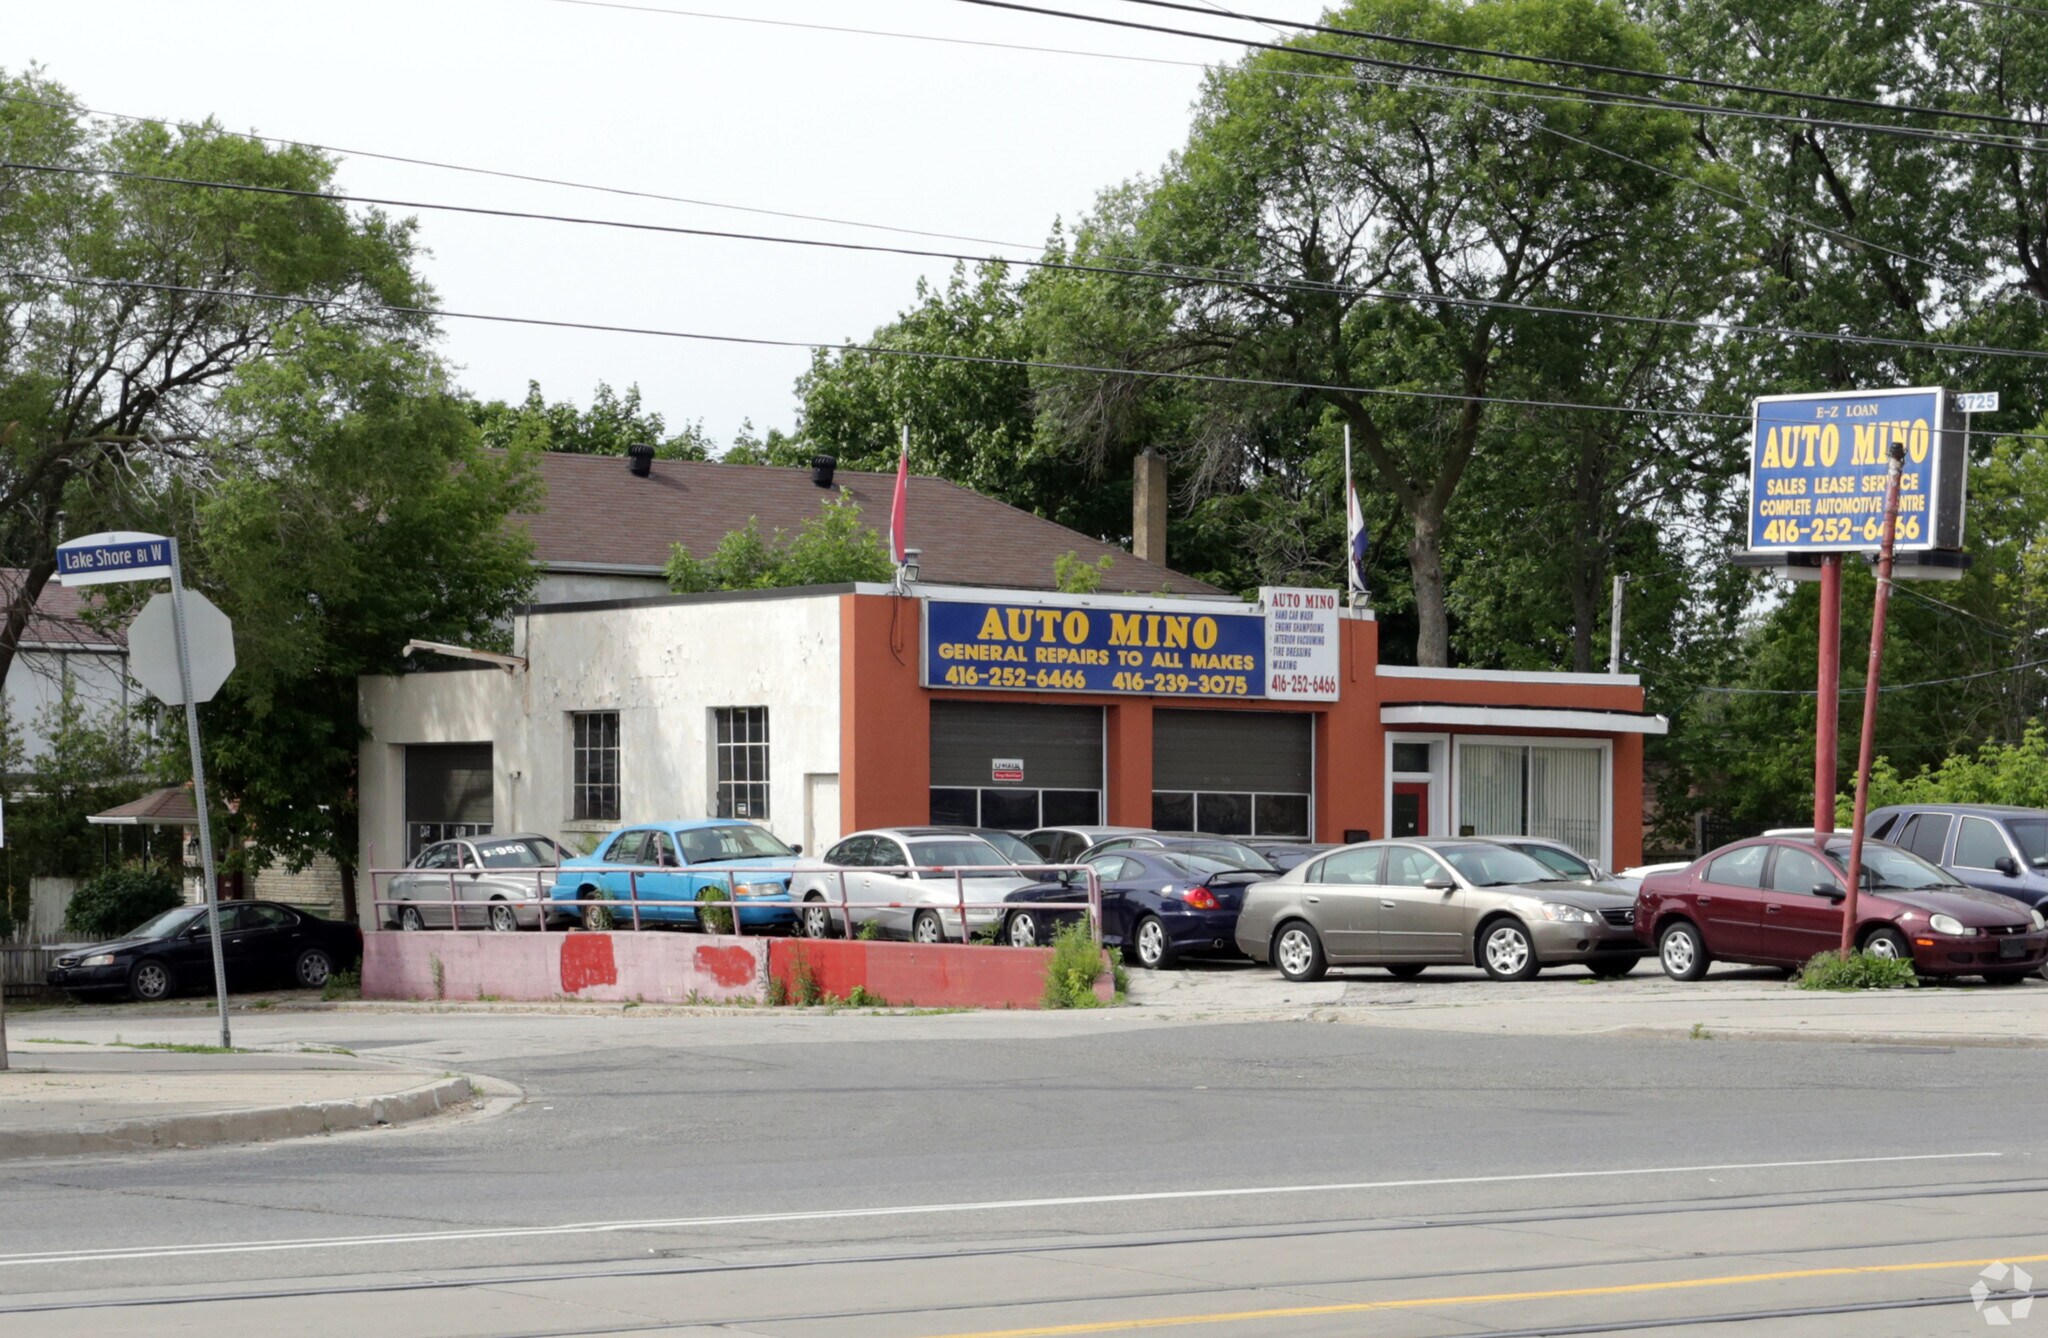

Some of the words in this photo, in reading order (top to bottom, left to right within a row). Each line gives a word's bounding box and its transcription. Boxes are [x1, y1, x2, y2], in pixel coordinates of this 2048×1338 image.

[1957, 394, 1996, 410] 3725
[1816, 405, 1838, 419] E-Z
[1846, 404, 1879, 417] LOAN
[1761, 423, 1840, 469] AUTO
[1851, 418, 1929, 466] MINO
[1767, 477, 1807, 495] SALES
[1814, 475, 1855, 494] LEASE
[1862, 473, 1919, 493] SERCE
[1760, 498, 1811, 516] COMPLETE
[1815, 496, 1882, 515] AUTOMOTIVE
[1896, 494, 1925, 512] NTRE
[65, 552, 93, 569] Lake
[96, 549, 132, 566] Shore
[150, 544, 162, 561] W
[1272, 593, 1300, 608] AUTO
[1305, 594, 1334, 609] MINO
[1275, 610, 1288, 620] HAND
[1289, 610, 1299, 620] CAR
[1300, 610, 1314, 620] WASH
[977, 607, 1090, 645] AUTO
[1108, 612, 1218, 650] MINO
[1274, 622, 1292, 632] ENGINE
[1293, 622, 1324, 633] SHAMPOOING
[1273, 634, 1296, 645] INTERIOR
[1296, 635, 1325, 646] VACUUMING
[938, 642, 1028, 662] GENERAL
[1035, 646, 1109, 666] REPAIRS
[1117, 650, 1143, 667] TO
[1151, 652, 1183, 668] ALL
[1191, 653, 1255, 670] MAKES
[1273, 646, 1285, 657] TIRE
[1286, 647, 1312, 657] DRESSING
[1272, 660, 1298, 670] WAXING
[945, 665, 1086, 689] 416-252-6466
[1112, 671, 1247, 694] 416-239-3075
[1272, 674, 1336, 693] 416-252-6466
